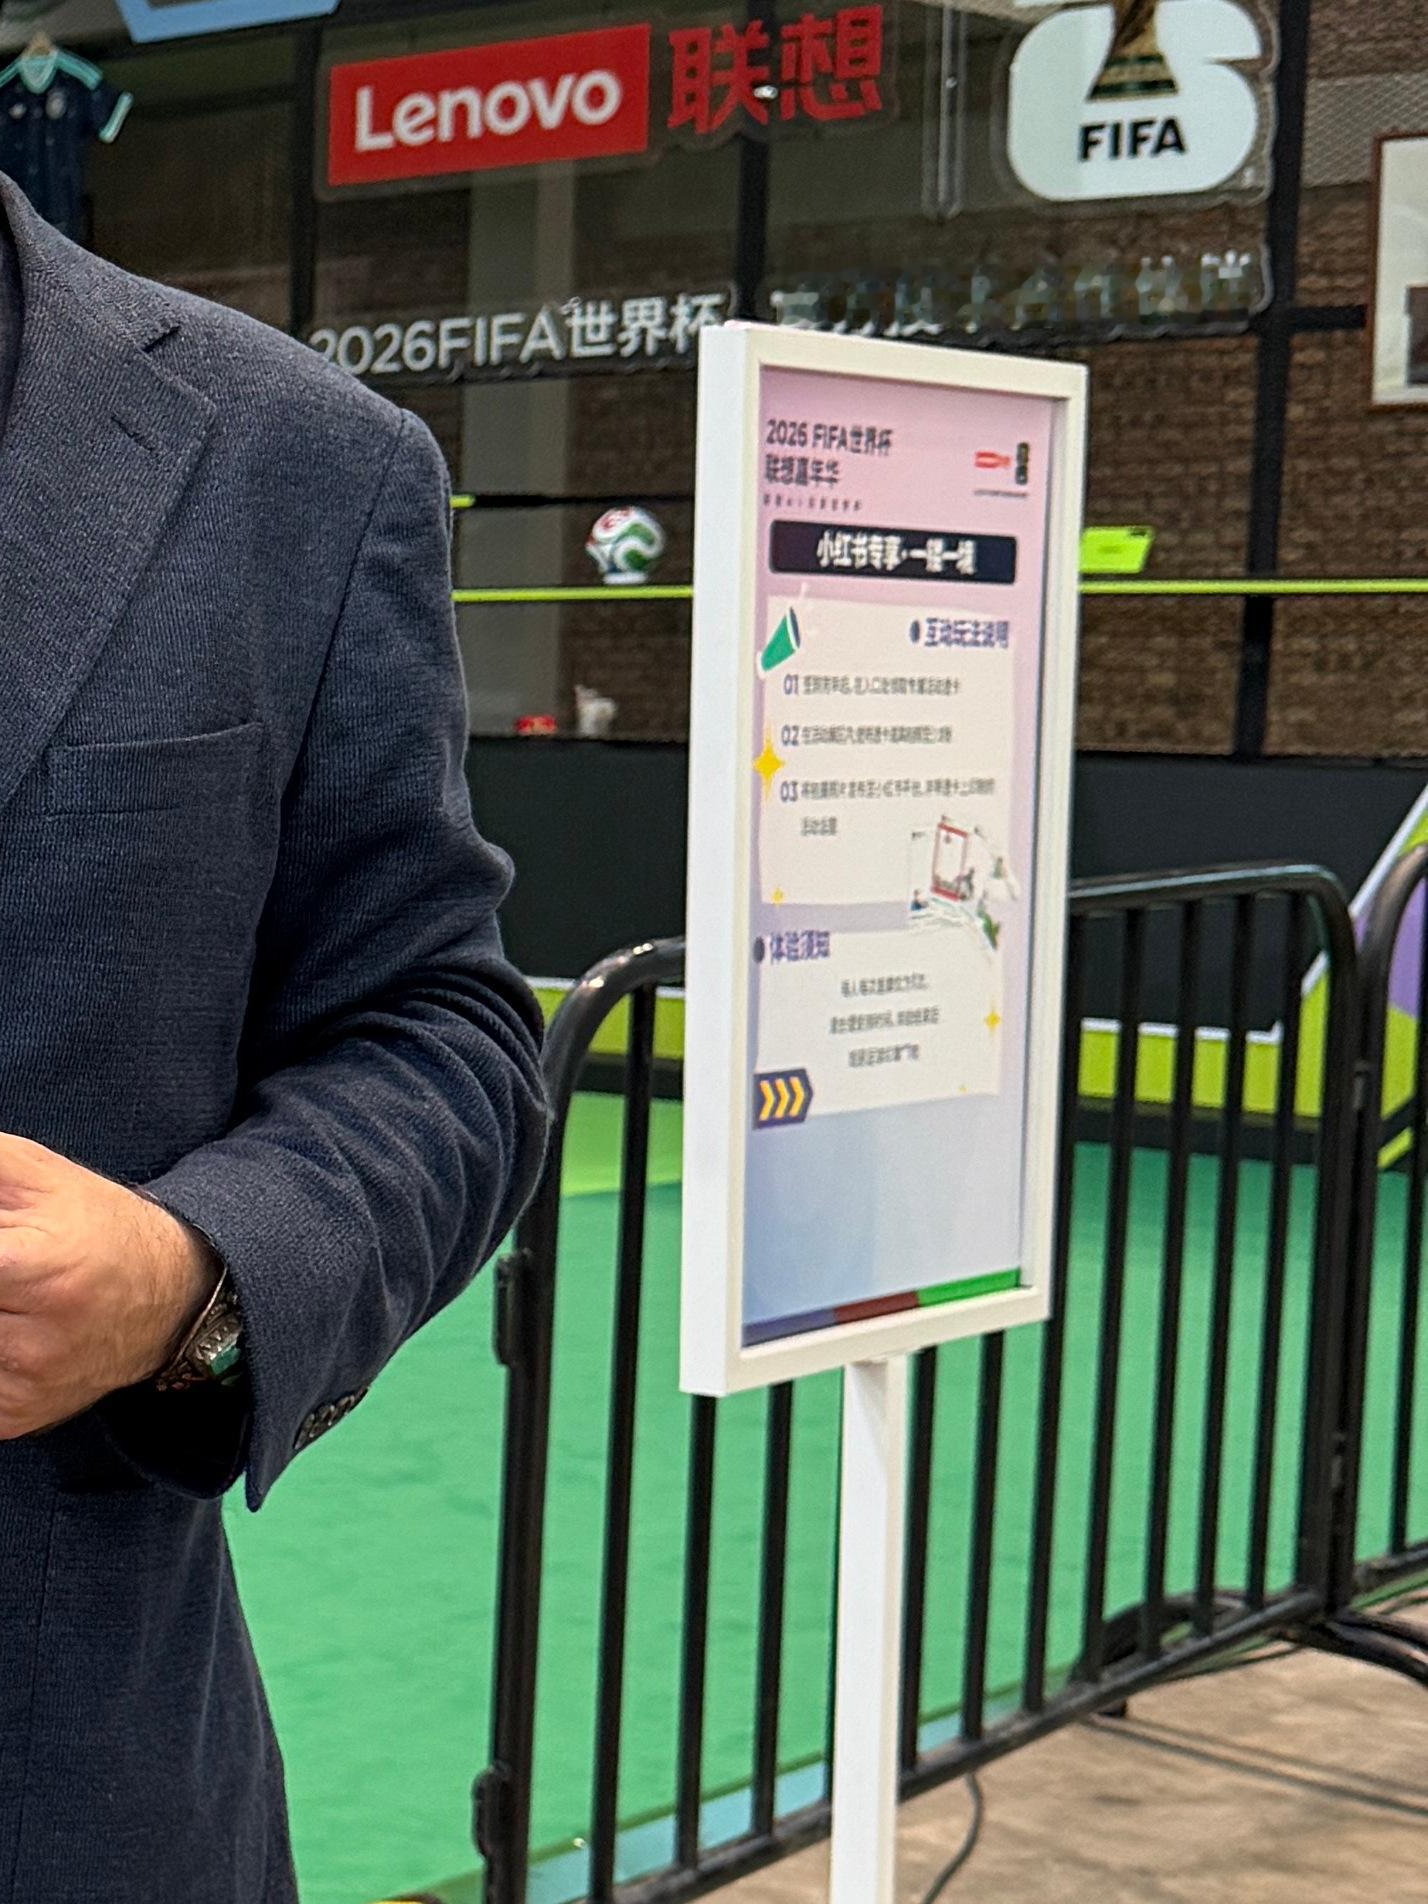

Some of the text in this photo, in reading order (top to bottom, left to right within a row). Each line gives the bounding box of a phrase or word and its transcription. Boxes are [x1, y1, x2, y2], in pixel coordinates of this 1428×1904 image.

[354, 4, 882, 153] Lenovo 联想
[1078, 117, 1188, 163] FIFA
[766, 418, 807, 447] 2026
[781, 725, 800, 746] 02
